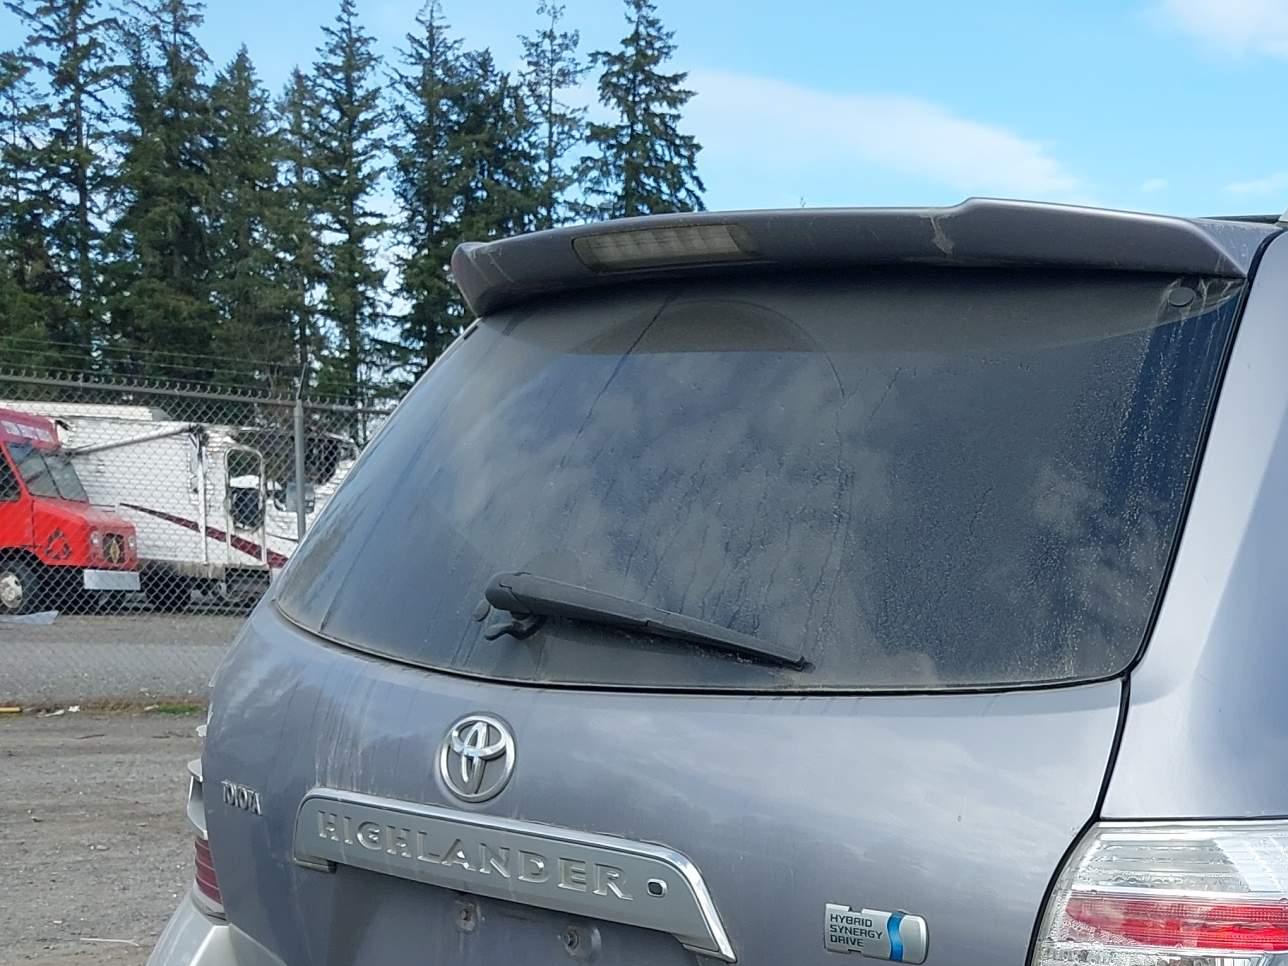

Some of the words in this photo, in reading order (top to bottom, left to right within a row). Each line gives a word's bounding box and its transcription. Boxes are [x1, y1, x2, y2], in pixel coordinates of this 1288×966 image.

[316, 808, 634, 901] HIGHLANDER
[829, 913, 873, 928] HYBRID
[829, 924, 884, 940] SYNERGY
[829, 934, 865, 948] DRIVE
